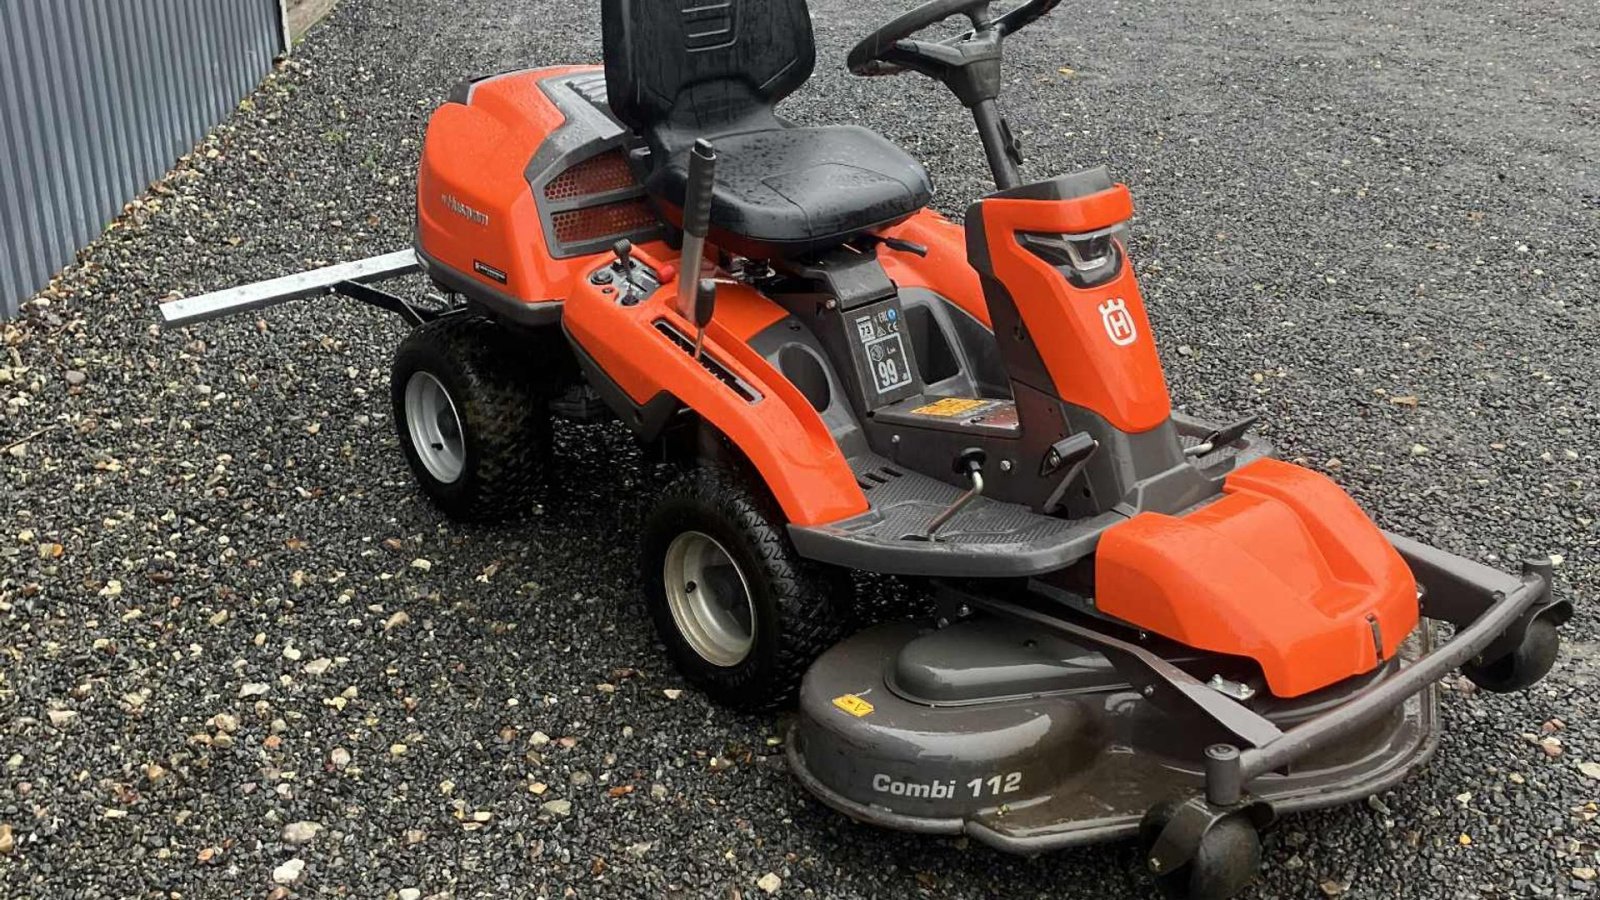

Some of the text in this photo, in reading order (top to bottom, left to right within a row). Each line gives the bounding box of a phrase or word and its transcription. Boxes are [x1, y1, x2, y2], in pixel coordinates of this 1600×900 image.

[860, 325, 871, 336] 73
[878, 359, 899, 386] 99
[872, 771, 1022, 799] Combi 112
